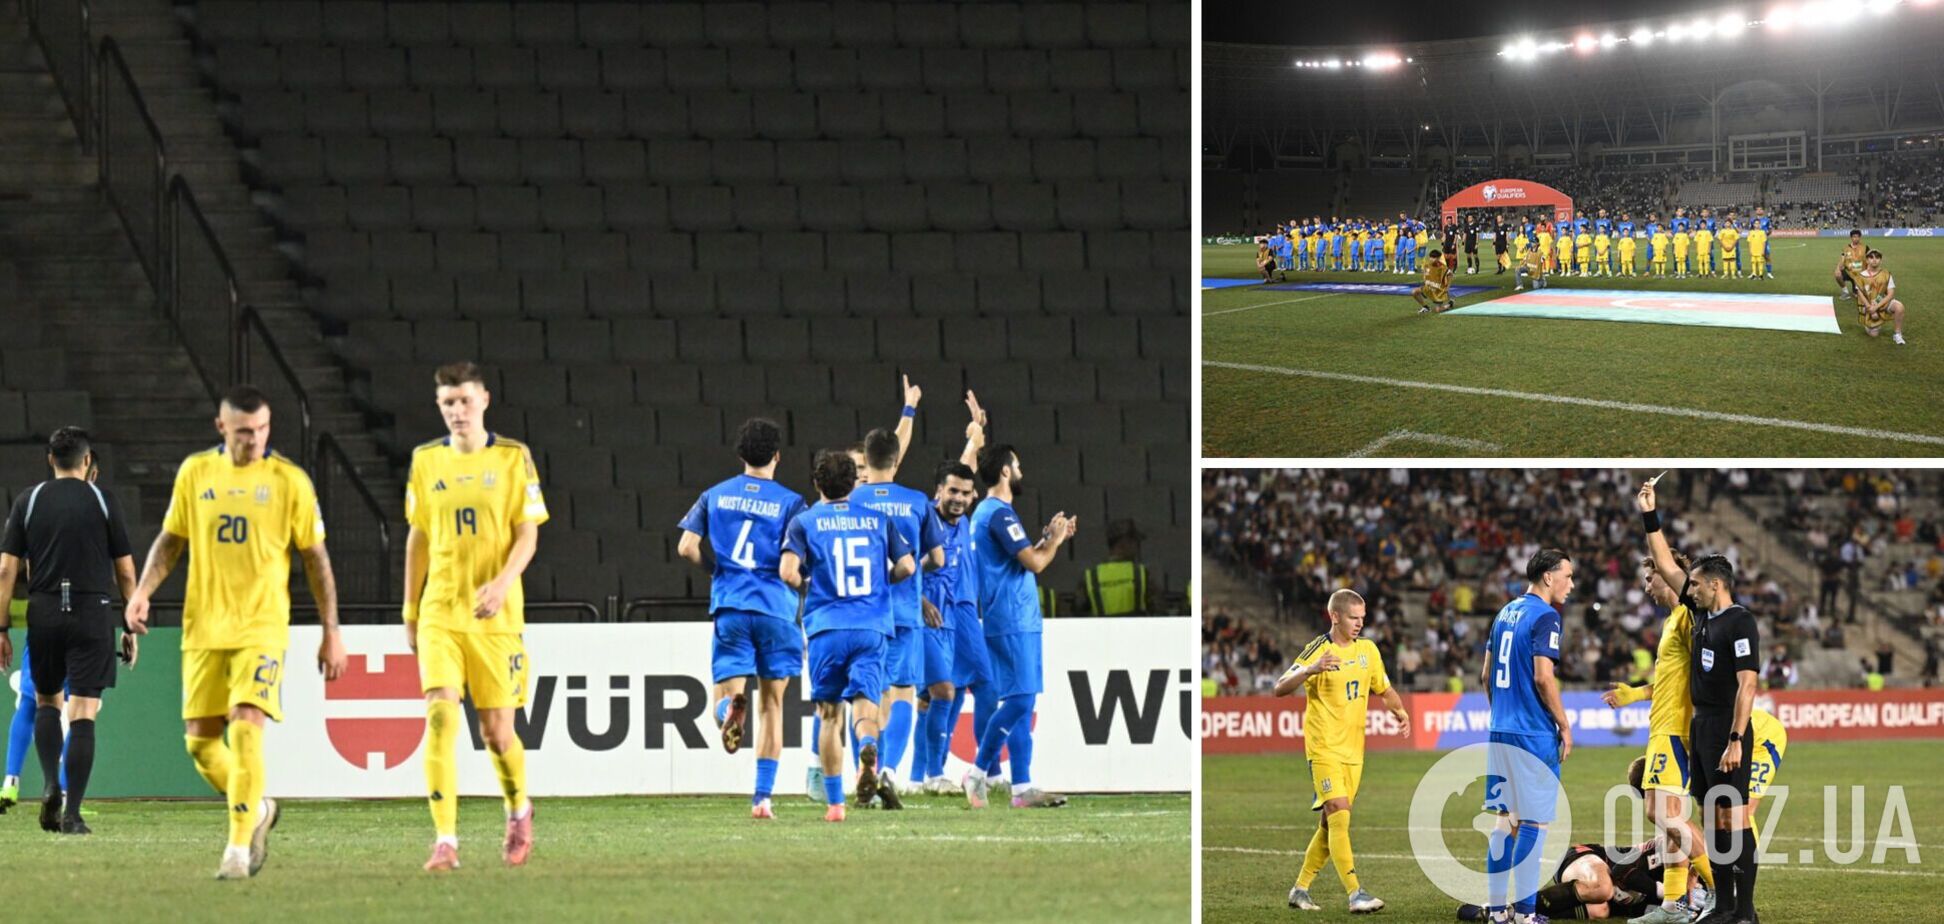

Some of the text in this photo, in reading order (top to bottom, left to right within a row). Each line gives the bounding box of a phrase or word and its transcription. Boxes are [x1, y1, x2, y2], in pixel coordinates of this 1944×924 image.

[217, 514, 248, 544] 20
[456, 507, 477, 536] 19
[731, 519, 756, 570] 4
[833, 537, 872, 597] 15
[254, 654, 279, 687] 20
[1496, 631, 1513, 688] 9
[1346, 680, 1359, 701] 17
[1423, 710, 1467, 732] FIFA
[1778, 703, 1878, 729] EUROPEAN
[1649, 753, 1668, 773] 13
[1751, 761, 1770, 783] 22
